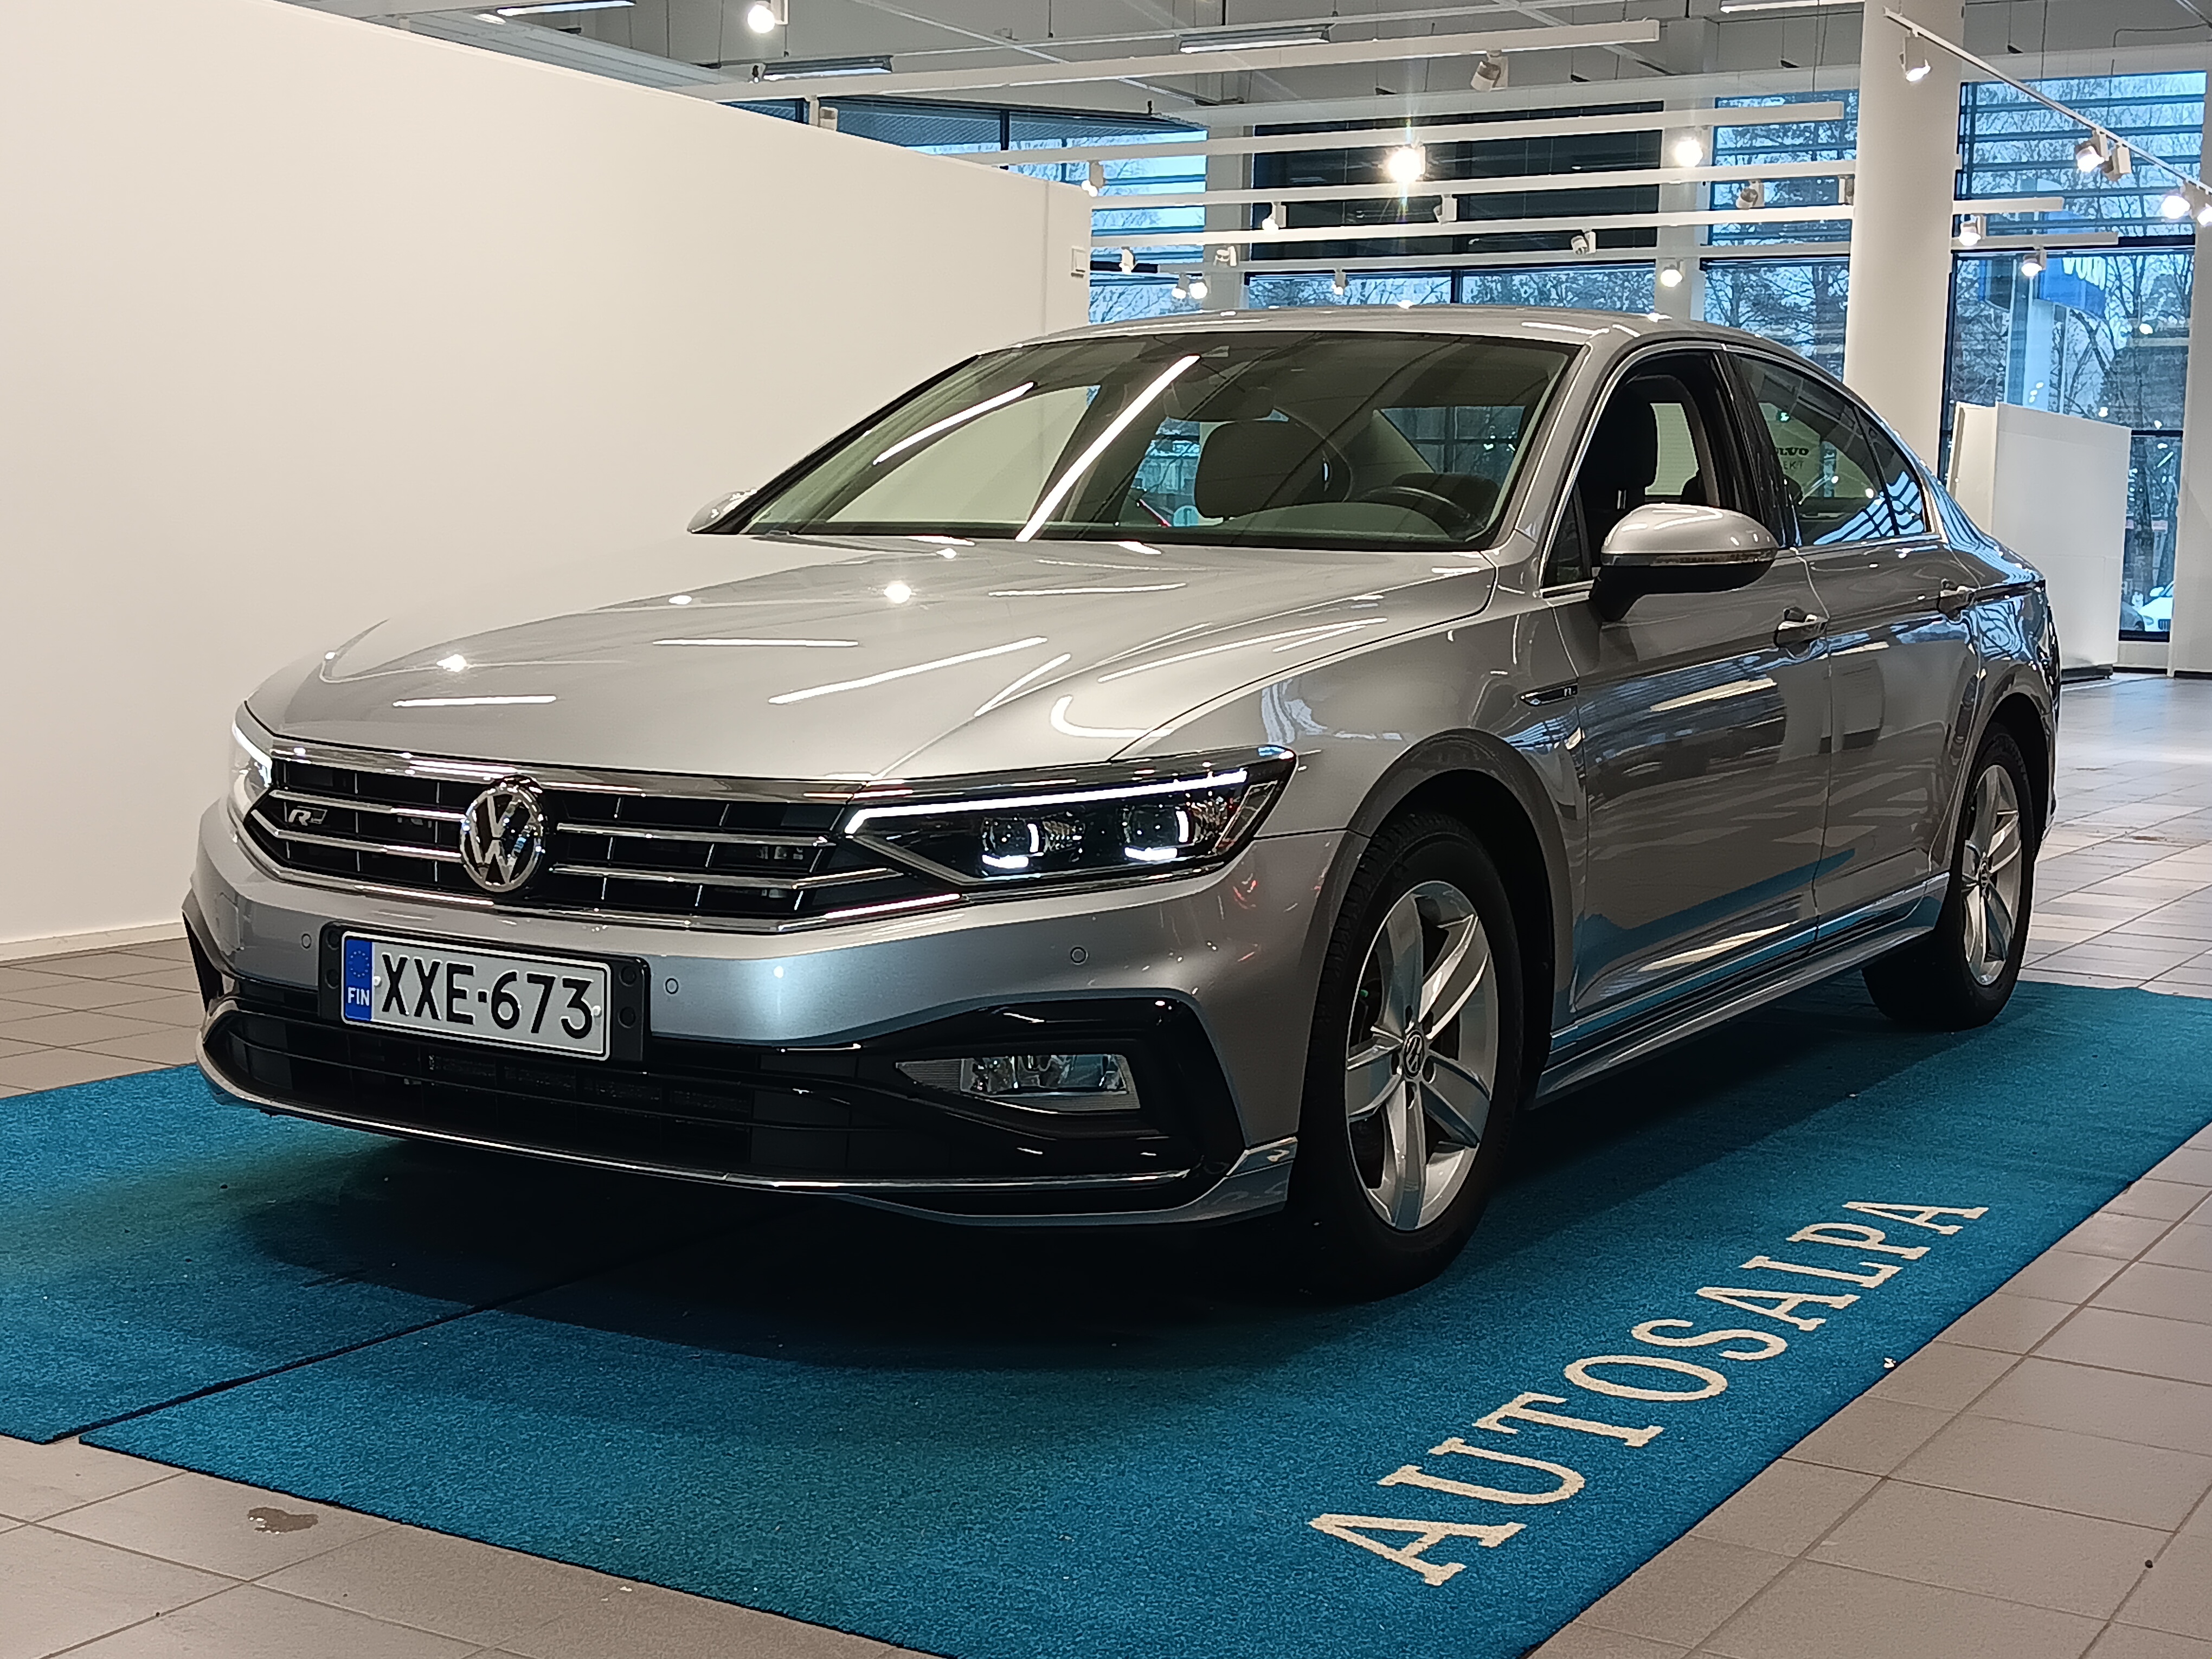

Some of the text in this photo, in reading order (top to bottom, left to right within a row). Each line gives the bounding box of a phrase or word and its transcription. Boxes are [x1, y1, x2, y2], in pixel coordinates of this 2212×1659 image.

[1777, 447, 1809, 455] LVO
[348, 988, 371, 1007] FIN
[382, 953, 593, 1039] XXE-673
[1308, 1200, 1989, 1586] AUTOSALPA
